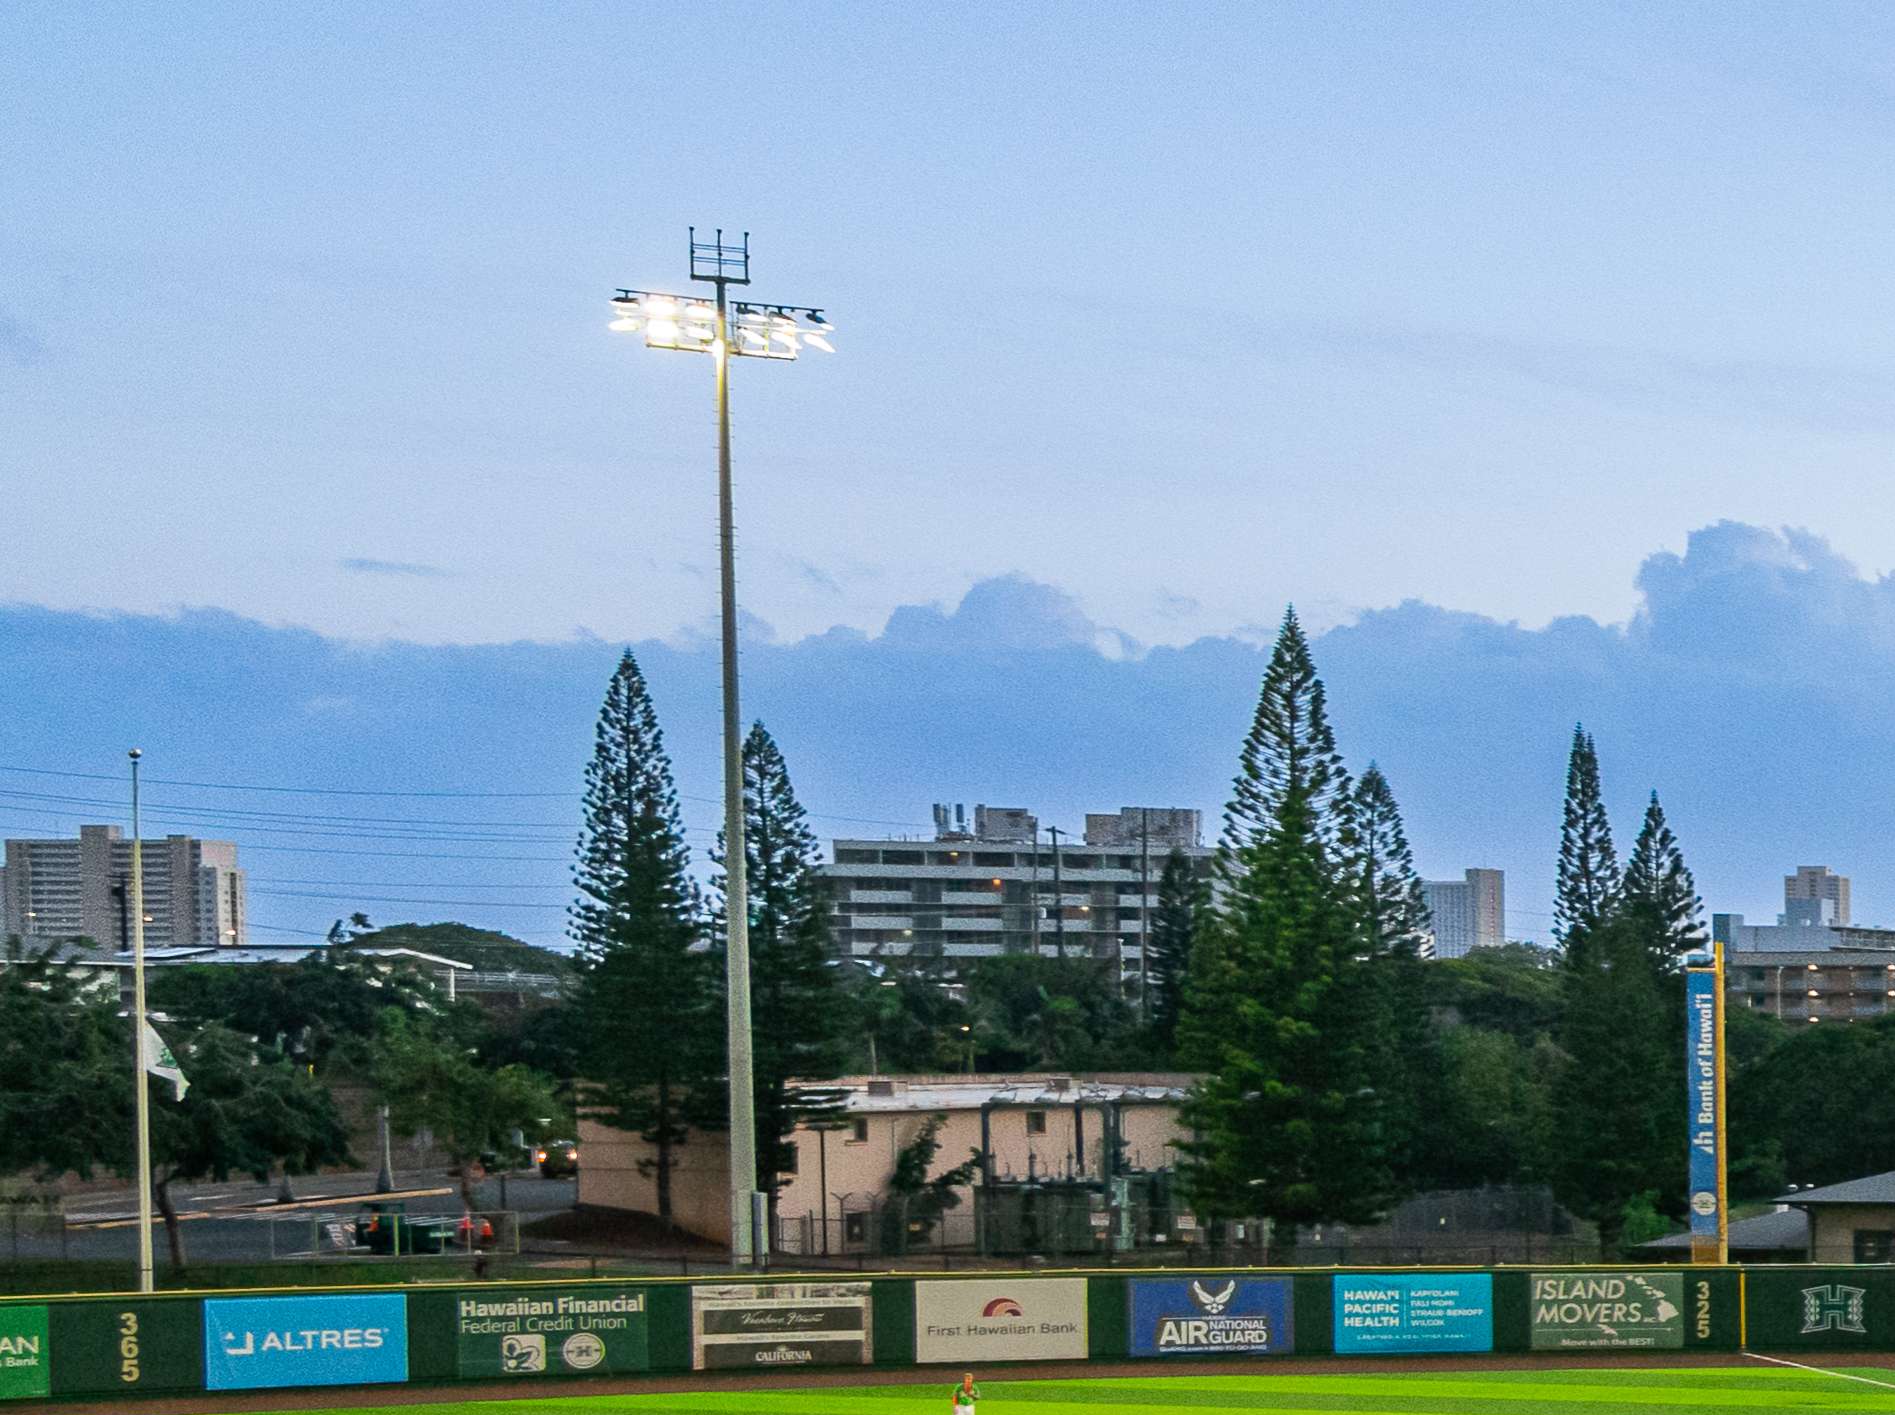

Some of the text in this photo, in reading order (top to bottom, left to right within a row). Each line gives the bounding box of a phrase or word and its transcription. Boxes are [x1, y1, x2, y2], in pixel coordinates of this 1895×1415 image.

[1698, 1058, 1714, 1077] of
[1697, 1080, 1714, 1124] Bank
[1535, 1279, 1625, 1300] ISLAND
[460, 1294, 645, 1317] Hawaiian Financial
[1344, 1303, 1400, 1314] PACIFIC
[1535, 1302, 1643, 1324] MOVERS
[461, 1313, 627, 1334] Federal Credit Union
[927, 1322, 1078, 1337] First Hawaiian Bank
[1344, 1316, 1400, 1327] HEALTH
[262, 1327, 384, 1350] ALTRES
[1159, 1319, 1267, 1345] AIR NATIONAL
[1208, 1330, 1267, 1344] GUARD
[1560, 1338, 1588, 1346] Move
[1589, 1338, 1610, 1346] with
[1611, 1337, 1627, 1345] the
[120, 1312, 140, 1382] 365
[755, 1350, 813, 1362] CALIFORNIA
[6, 1355, 39, 1368] Bank
